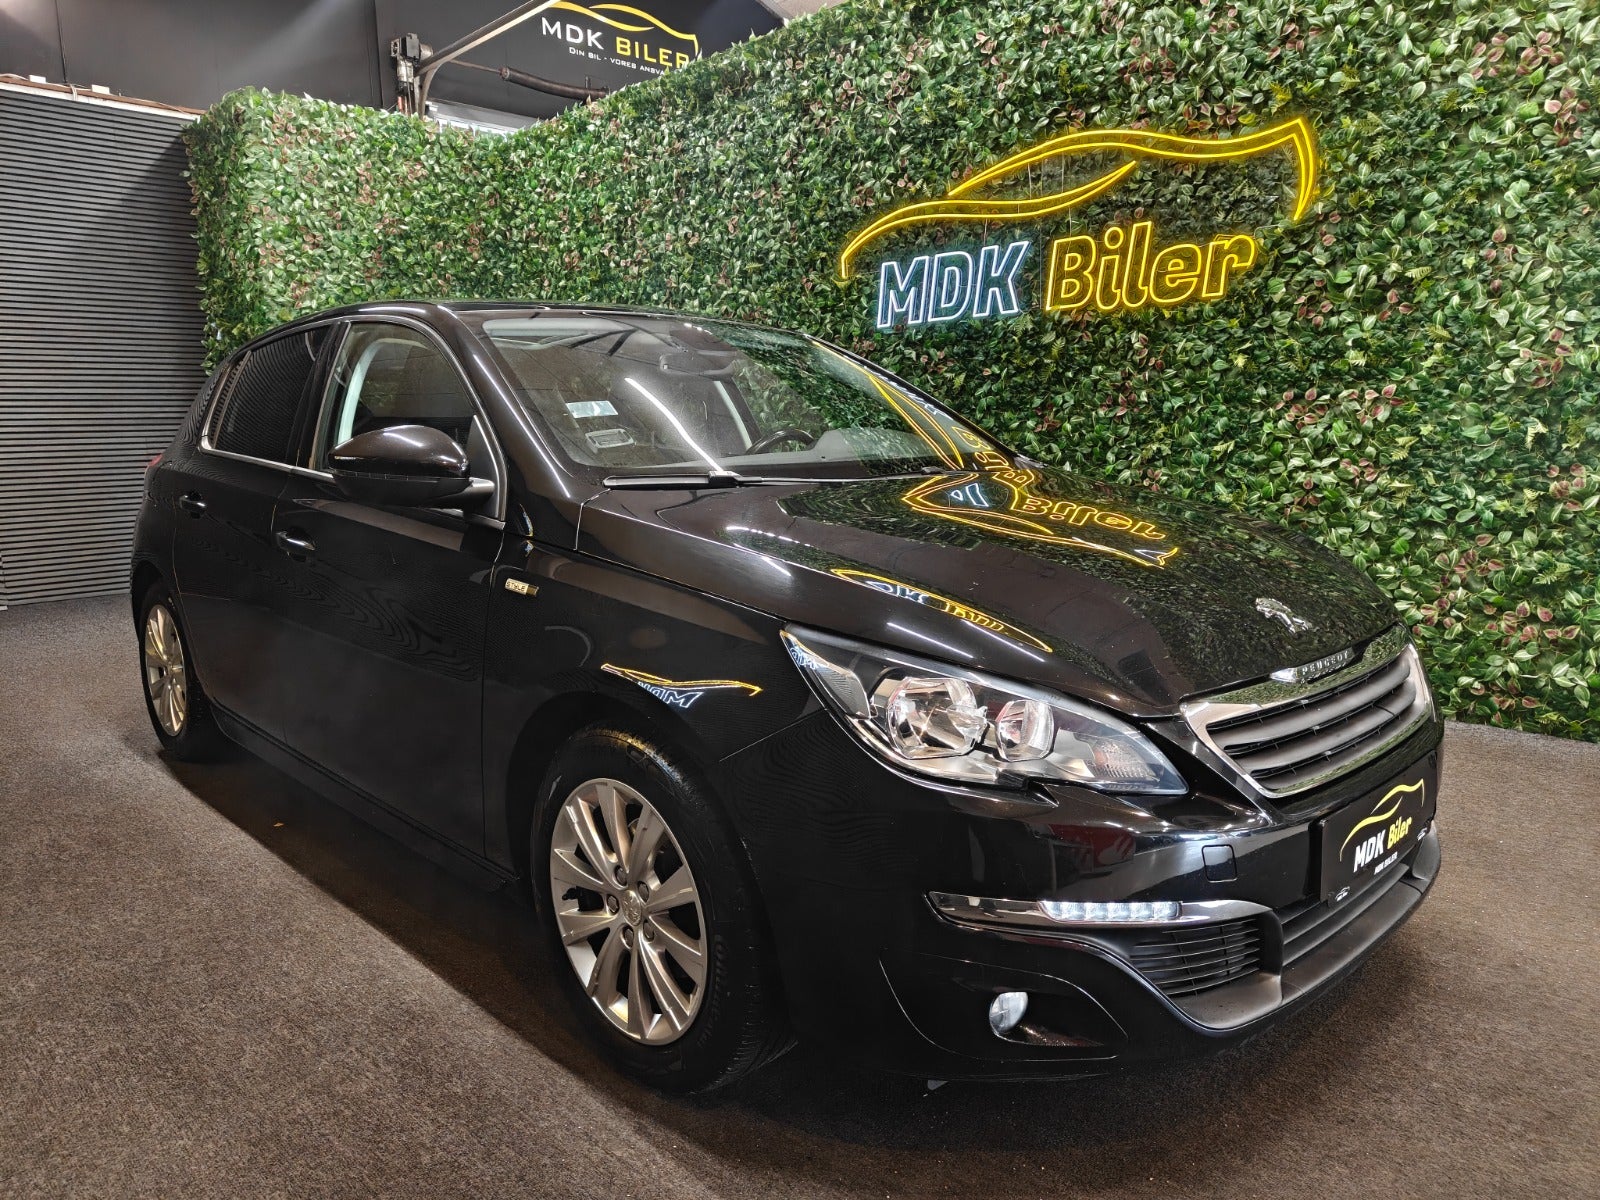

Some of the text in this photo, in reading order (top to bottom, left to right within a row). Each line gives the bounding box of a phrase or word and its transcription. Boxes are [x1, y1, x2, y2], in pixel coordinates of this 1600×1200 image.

[541, 17, 690, 69] MDK BILER
[877, 220, 1257, 328] MDK Biler
[1353, 816, 1412, 873] MDK Biler
